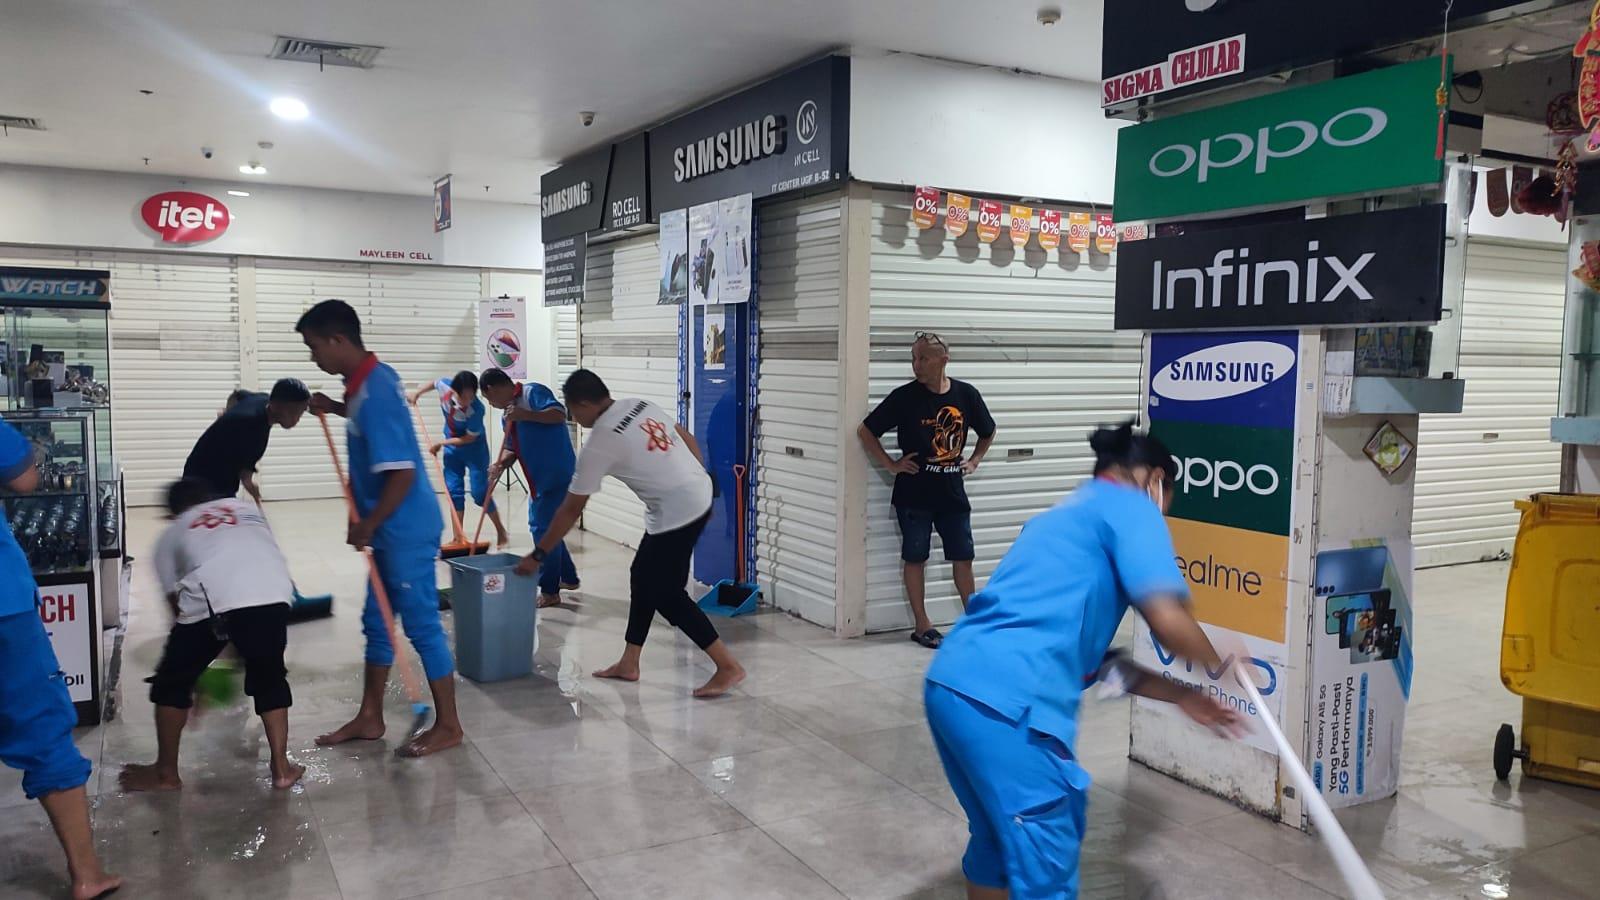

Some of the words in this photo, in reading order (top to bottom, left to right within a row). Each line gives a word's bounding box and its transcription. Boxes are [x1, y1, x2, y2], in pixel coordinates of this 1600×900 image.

[1104, 67, 1164, 104] SIGMA
[1171, 39, 1241, 85] CELULAR
[674, 114, 776, 183] SAMSUNG
[1149, 107, 1388, 183] oppo
[801, 148, 820, 164] CELL
[778, 177, 800, 192] CENTER
[541, 181, 588, 218] SAMSUNG
[613, 201, 623, 218] RO
[624, 197, 641, 214] CELL
[915, 196, 937, 214] 0%
[947, 204, 970, 223] 0%
[980, 211, 1000, 228] 0%
[1011, 217, 1031, 234] 0%
[1041, 220, 1059, 235] 0%
[1070, 223, 1090, 238] 0%
[1097, 224, 1116, 238] 0%
[359, 249, 405, 259] MAYLEEN
[409, 251, 433, 260] CELL
[1152, 240, 1376, 310] Infinix
[1, 277, 97, 295] WATCH
[1170, 361, 1274, 384] SAMSUNG
[612, 415, 634, 435] TEAM
[925, 464, 942, 473] THE
[1174, 554, 1262, 596] ealme
[1208, 684, 1258, 715] Phone
[1319, 684, 1326, 700] 5G
[1330, 683, 1342, 755] Pasti-Pasti
[1341, 676, 1355, 768] Performanya
[1316, 720, 1326, 759] Galaxy
[1329, 757, 1339, 793] Yang
[1339, 770, 1349, 795] 5G
